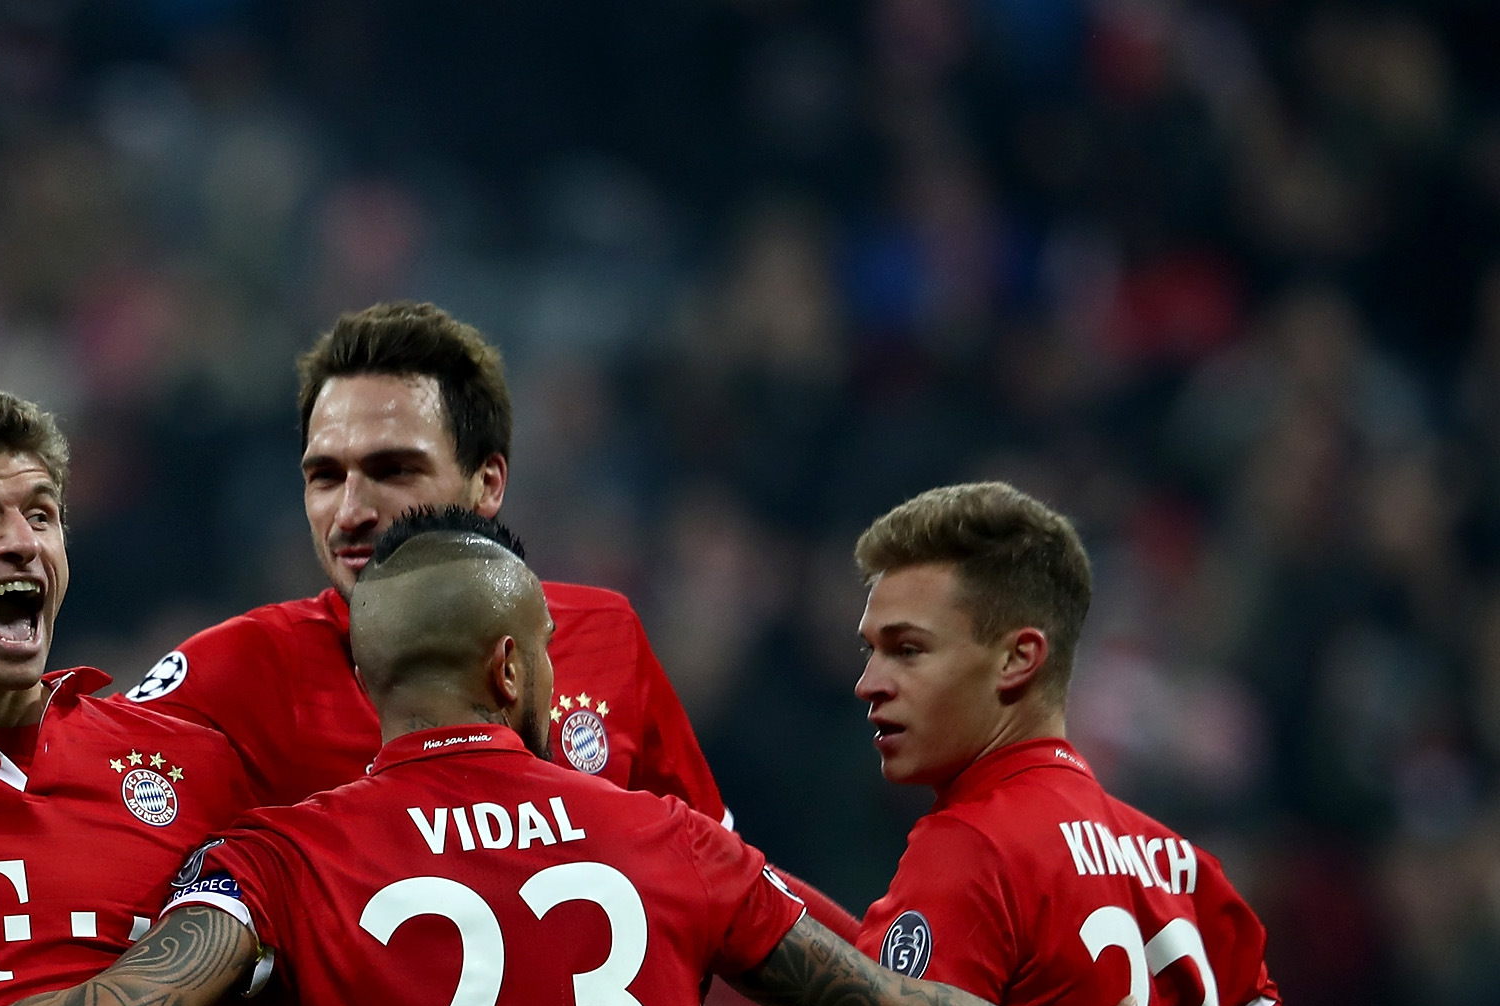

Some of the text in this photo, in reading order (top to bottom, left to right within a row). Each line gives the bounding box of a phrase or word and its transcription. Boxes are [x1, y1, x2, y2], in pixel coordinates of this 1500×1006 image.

[136, 772, 173, 798] BAYERN
[406, 797, 586, 854] VIDAL
[173, 879, 238, 900] RESPECT
[896, 949, 910, 970] 5
